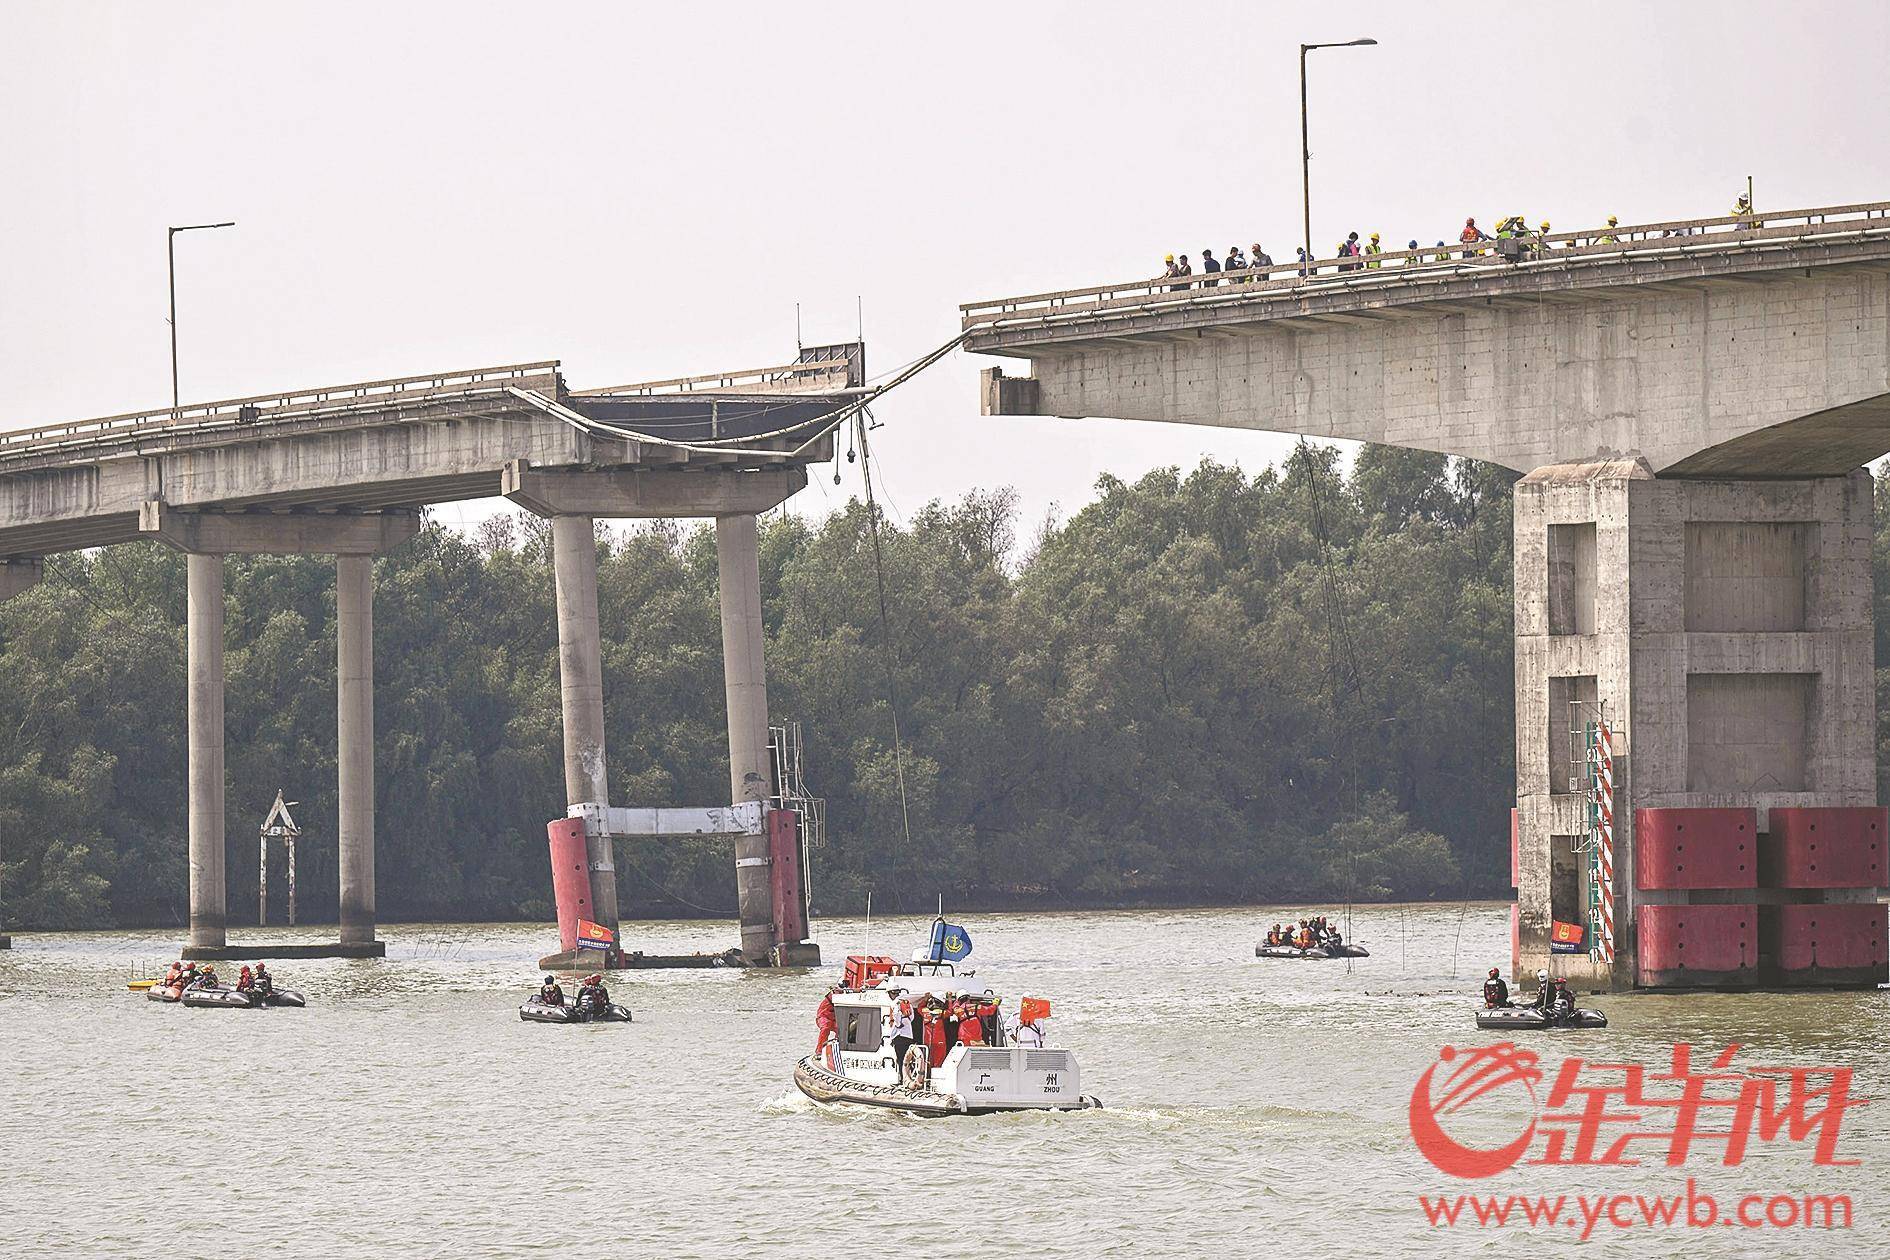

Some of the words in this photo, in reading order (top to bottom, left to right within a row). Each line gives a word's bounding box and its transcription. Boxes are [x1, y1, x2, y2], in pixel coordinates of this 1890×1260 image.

[979, 1072, 991, 1085] 广
[1045, 1073, 1058, 1086] 州
[974, 1085, 995, 1093] GUANG
